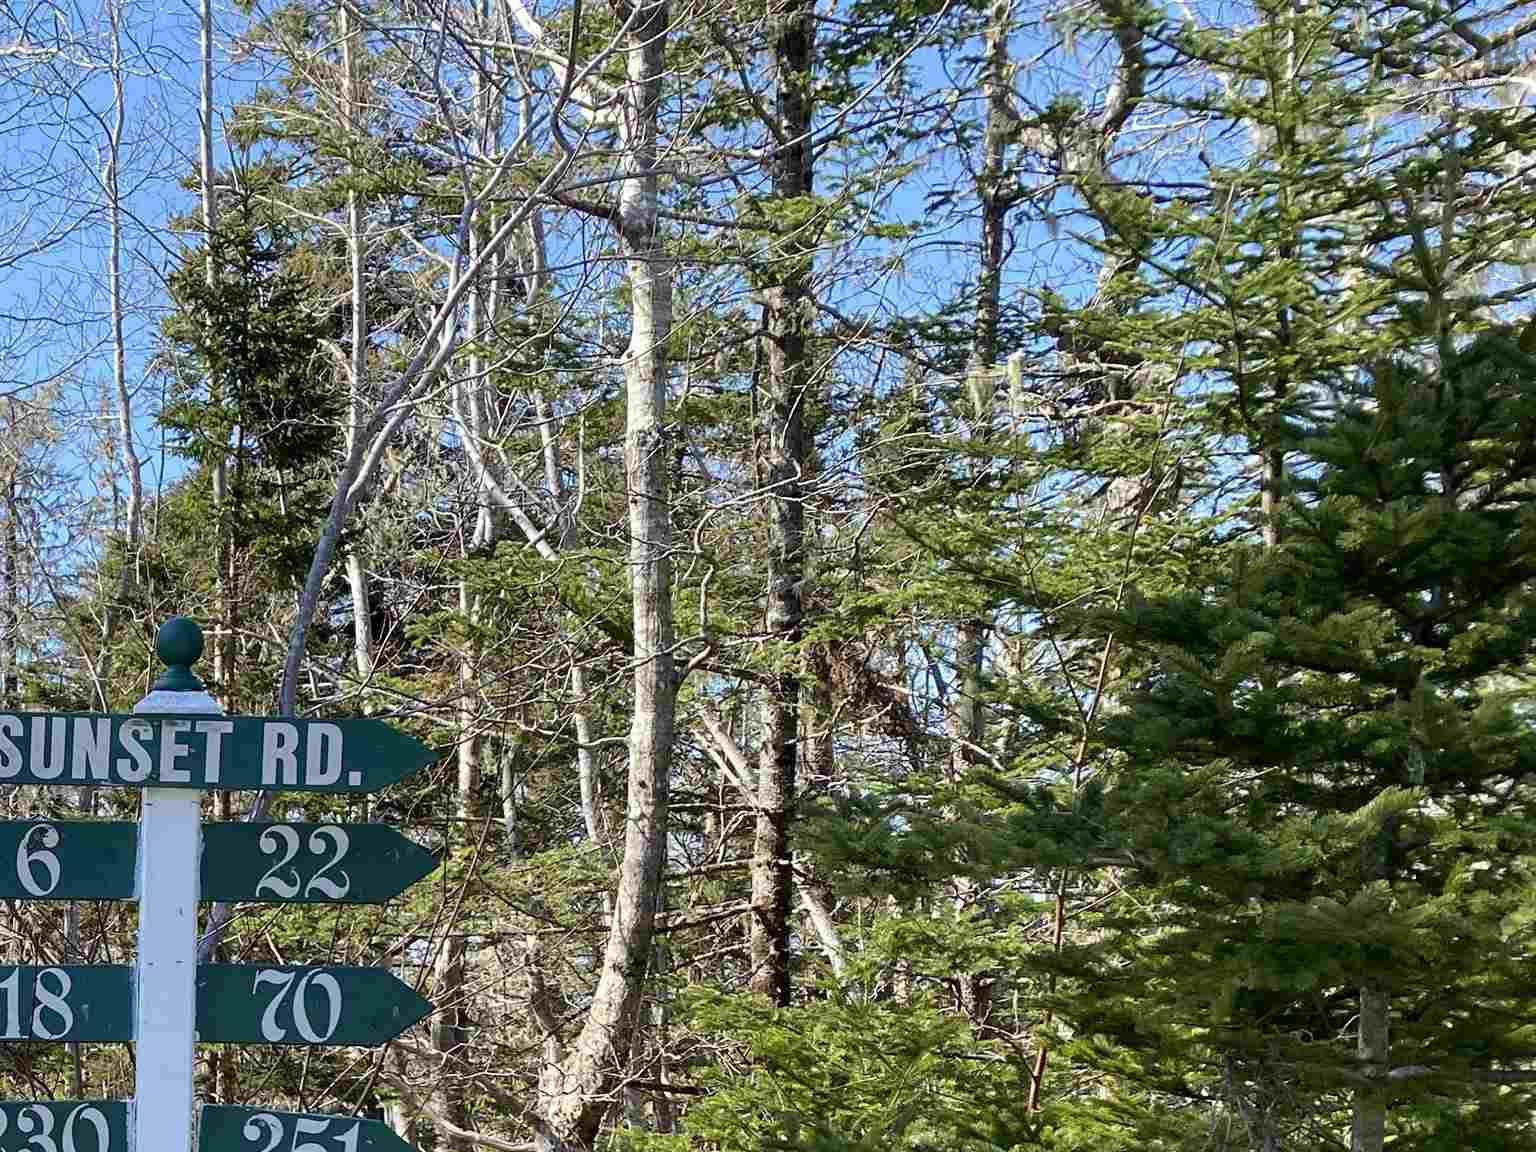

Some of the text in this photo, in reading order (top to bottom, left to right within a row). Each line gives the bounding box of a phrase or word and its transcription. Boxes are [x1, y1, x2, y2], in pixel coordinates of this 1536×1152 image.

[262, 722, 362, 786] RD.
[17, 824, 61, 896] 6
[255, 825, 350, 899] 22
[253, 967, 342, 1043] 70
